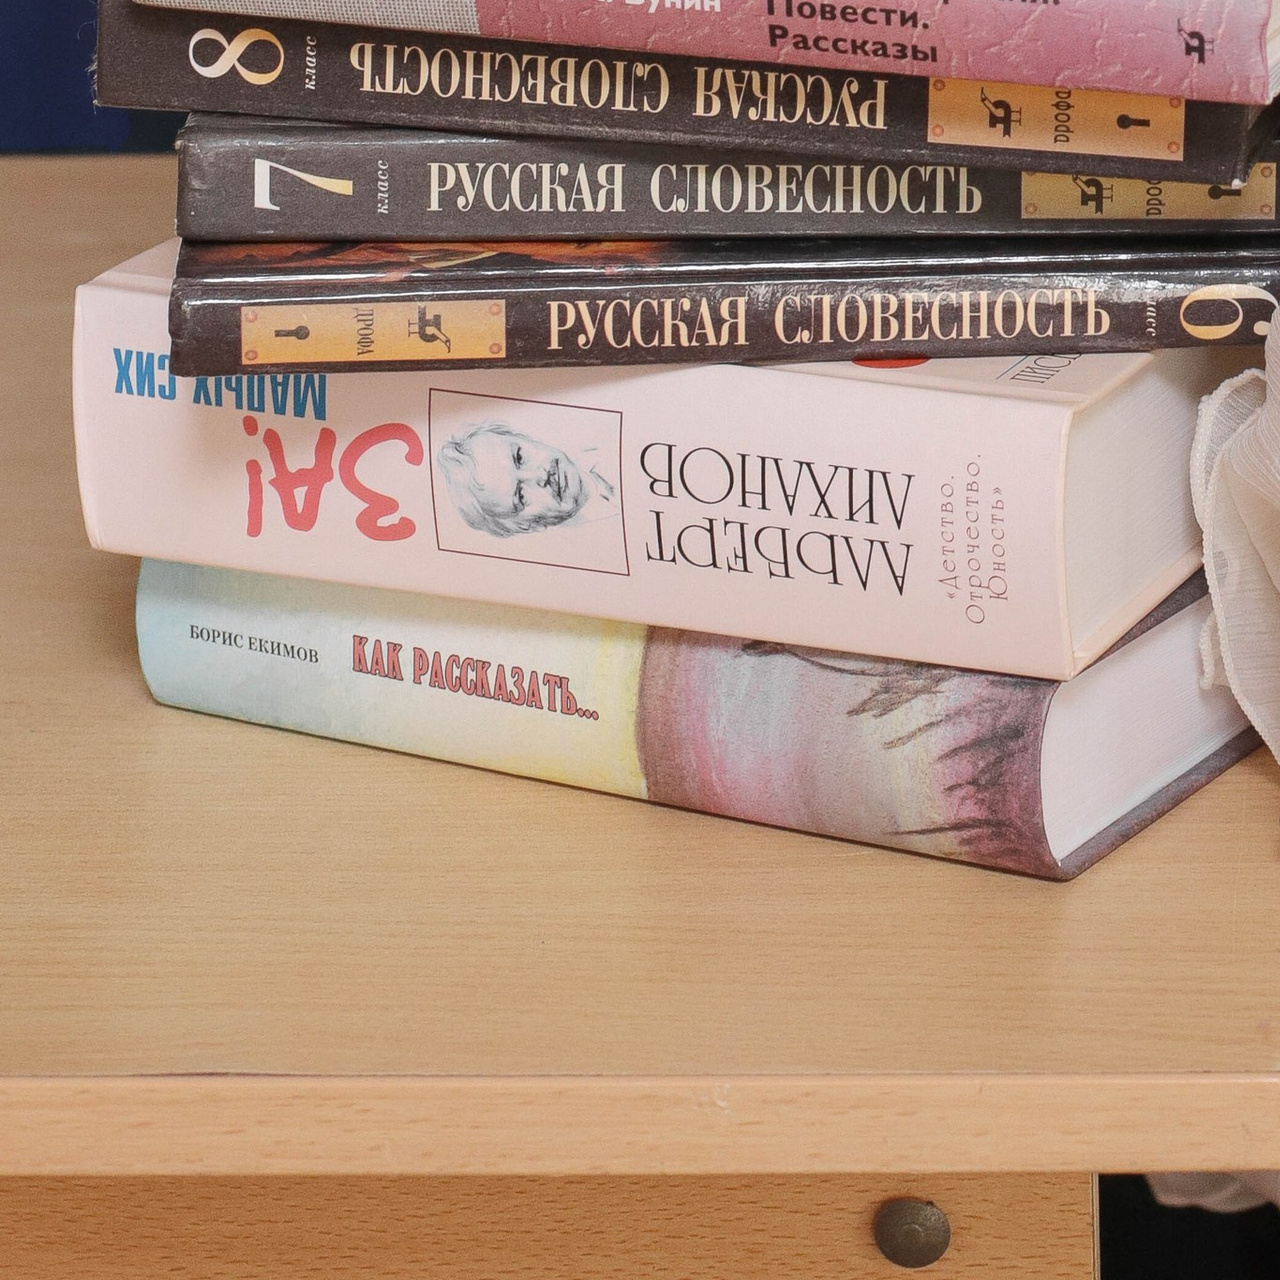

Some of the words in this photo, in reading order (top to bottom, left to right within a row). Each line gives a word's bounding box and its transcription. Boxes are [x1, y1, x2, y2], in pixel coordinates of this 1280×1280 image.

[189, 28, 284, 85] 8
[304, 36, 317, 90] класс
[768, 24, 938, 63] Рассказы
[350, 42, 671, 114] СЛОВЕСНОСТЬ
[692, 64, 889, 130] РУССКАЯ
[254, 158, 354, 212] 7
[377, 159, 390, 215] класс
[427, 162, 626, 214] РУССКАЯ
[651, 163, 983, 215] СЛОВЕСНОСТЬ
[546, 294, 749, 350] РУССКАЯ
[774, 288, 1111, 345] СЛОВЕСНОСТЬ
[113, 348, 176, 400] СИХ
[243, 415, 424, 541] ЗА!
[639, 442, 915, 531] ЛИХАНОВ
[646, 509, 914, 596] АЛЬБЕРТ
[189, 624, 244, 649] БОРИС
[248, 637, 319, 664] ЕКИМОВ
[352, 635, 404, 681] КАК
[413, 647, 600, 721] РАССКАЗАТЬ...
